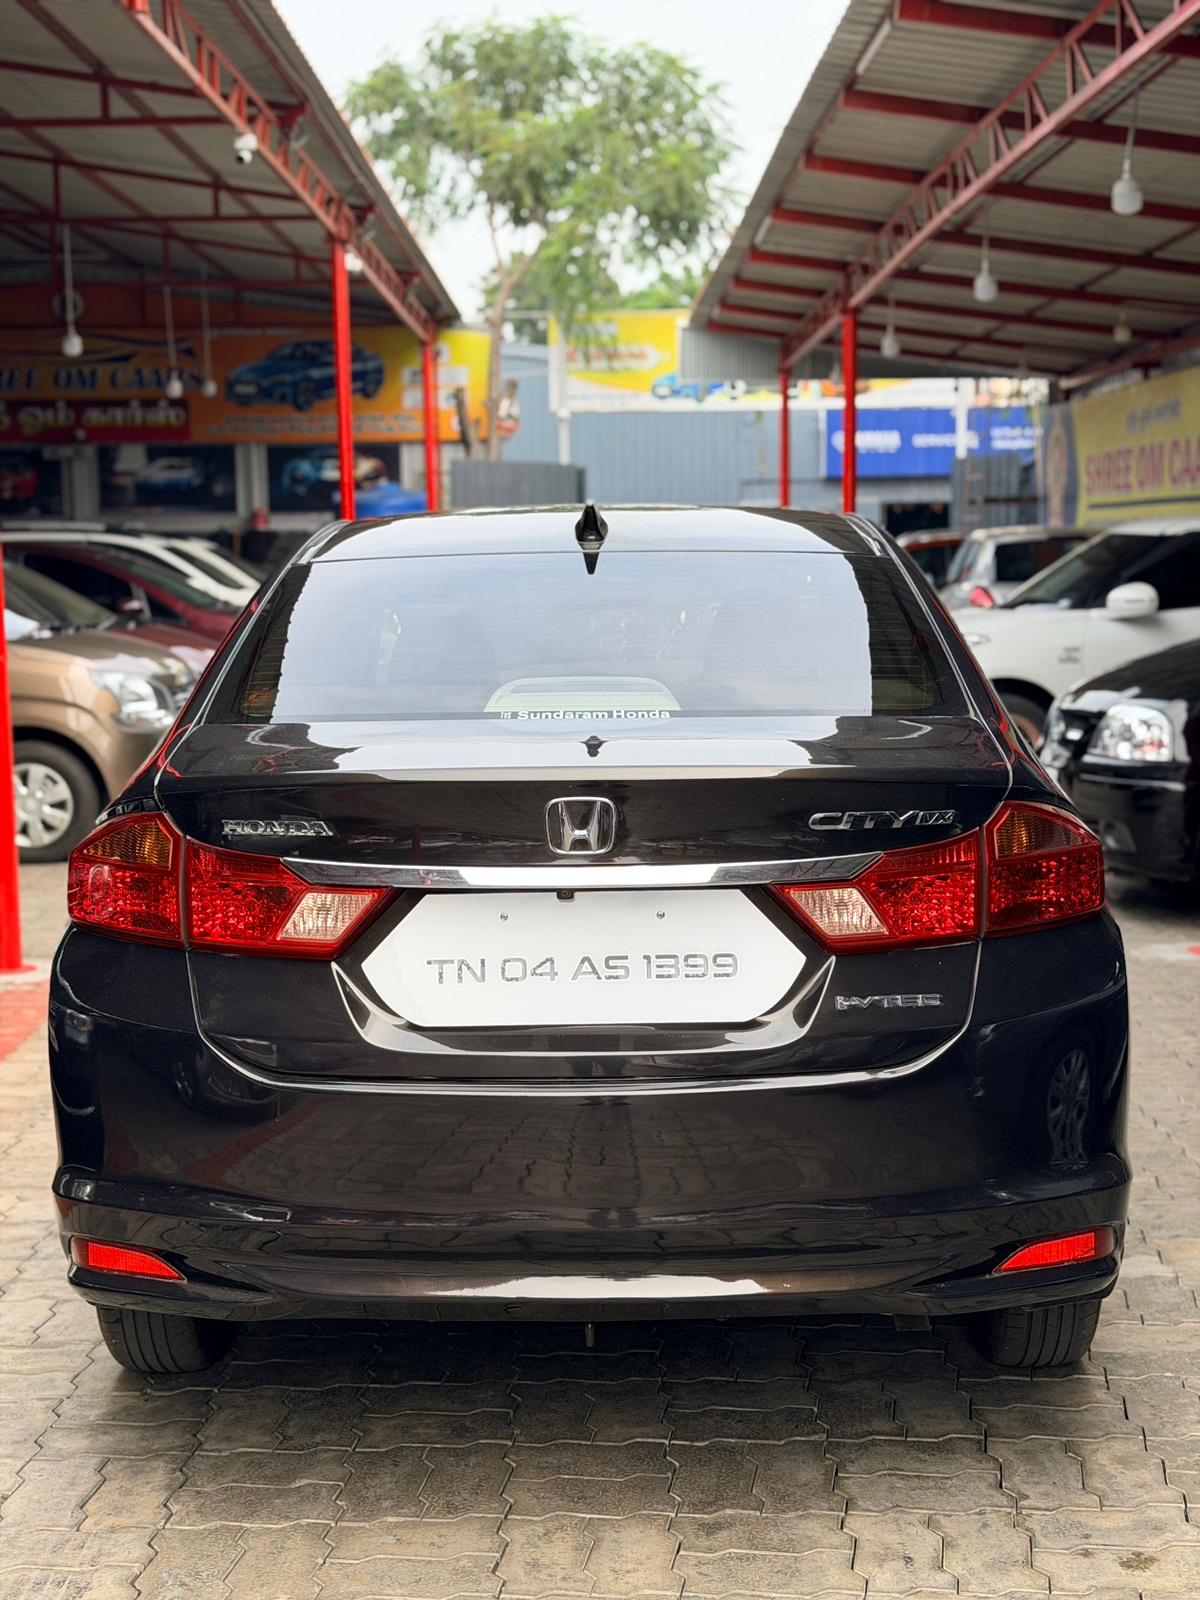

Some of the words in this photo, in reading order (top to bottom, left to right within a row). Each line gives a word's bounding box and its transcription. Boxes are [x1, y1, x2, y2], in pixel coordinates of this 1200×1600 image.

[53, 367, 99, 391] OM
[517, 709, 609, 720] Sundaram
[612, 708, 671, 720] Honda
[221, 819, 335, 837] HONDA
[808, 810, 919, 831] CITY
[426, 957, 487, 985] TN
[500, 956, 559, 983] 04
[570, 954, 630, 982] AS
[641, 952, 739, 981] 1399
